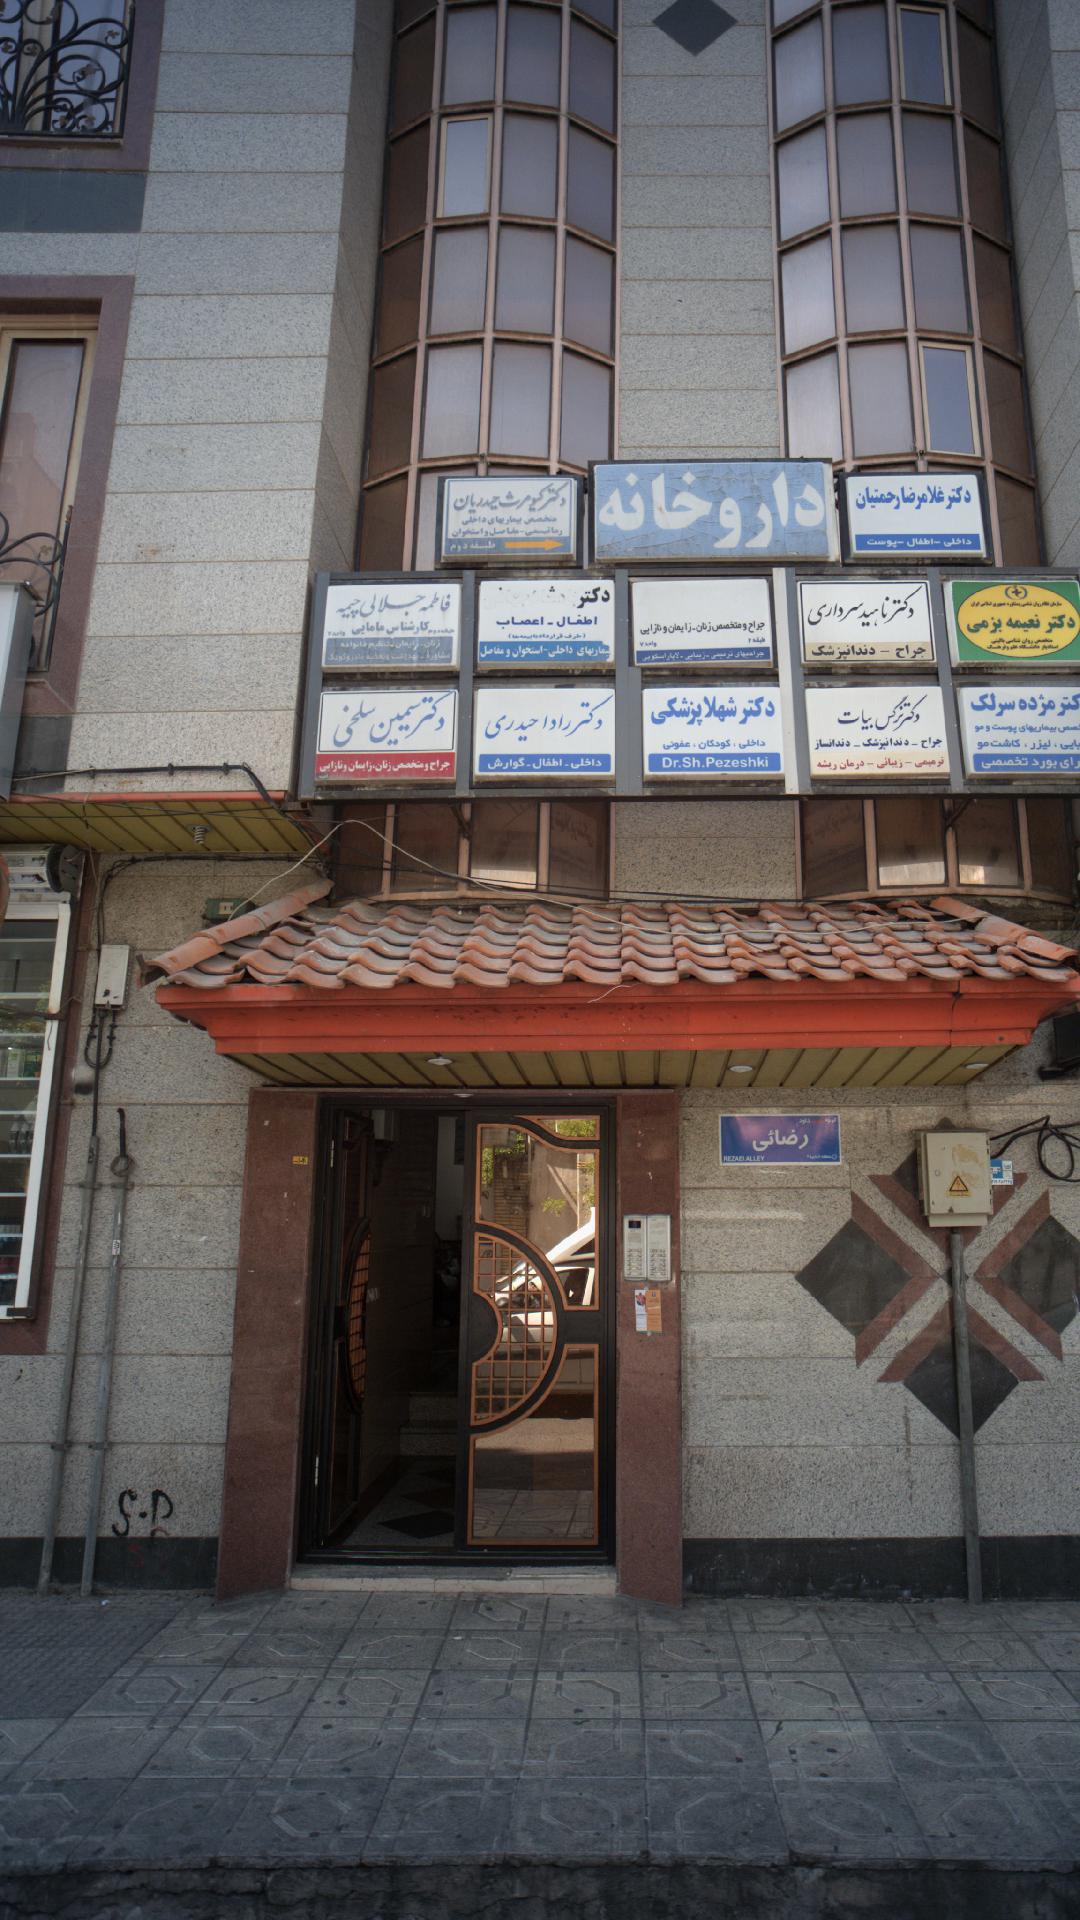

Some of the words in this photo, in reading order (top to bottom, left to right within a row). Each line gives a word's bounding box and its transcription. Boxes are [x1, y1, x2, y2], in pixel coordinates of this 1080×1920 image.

[500, 482, 554, 512] کیومرث
[538, 481, 569, 511] دکتر
[855, 487, 900, 510] رحمتیان
[900, 485, 945, 510] غلامرضا
[945, 486, 971, 510] دکتر
[454, 493, 500, 513] حیدریان
[598, 472, 826, 549] داروخانه
[462, 515, 485, 526] داخلی
[523, 515, 557, 525] متخصص
[450, 543, 468, 553] دوم
[470, 540, 496, 550] طبقه
[943, 538, 972, 547] داخلی
[419, 592, 451, 612] فاطمه
[577, 586, 610, 609] دکتر
[360, 593, 426, 617] جلالی
[884, 585, 922, 624] دکتر
[808, 602, 863, 625] سرداری
[857, 596, 890, 627] ناهید
[496, 616, 544, 629] اعصاب
[556, 614, 597, 627] اطفال
[695, 621, 711, 633] زنان
[712, 620, 742, 632] متخصص
[742, 622, 748, 631] و
[748, 620, 765, 633] جراح
[966, 616, 1002, 633] بزمی
[1006, 614, 1040, 632] نعیمه
[1045, 614, 1076, 633] دکتر
[352, 621, 384, 636] مامایی
[386, 620, 430, 636] کارشناس
[640, 623, 661, 635] نازایی
[662, 625, 668, 634] و
[668, 622, 692, 634] زایمان
[480, 645, 504, 658] مفاصل
[512, 645, 543, 658] استخوان
[548, 644, 574, 658] داخلی
[812, 645, 876, 660] دندانپزشک
[895, 645, 926, 658] جراح
[704, 695, 737, 722] شهلا
[739, 696, 775, 725] دکتر
[970, 692, 1016, 717] سرلک
[1019, 693, 1056, 717] مژده
[1057, 693, 1080, 717] کتر
[405, 690, 453, 739] دکتر
[565, 694, 613, 737] دکتر
[651, 697, 703, 726] پزشکی
[875, 694, 908, 730] نرگس
[893, 694, 927, 731] دکتر
[370, 703, 420, 746] سیمین
[837, 709, 873, 730] بیات
[485, 715, 538, 741] حیدری
[985, 724, 991, 732] و
[992, 723, 1017, 733] پوست
[1018, 723, 1057, 733] بیماریهای
[663, 740, 691, 750] عفونی
[698, 739, 731, 749] کودکان
[739, 739, 766, 749] داخلی
[815, 738, 851, 750] دندانساز
[862, 738, 909, 750] دندانپزشک
[921, 737, 942, 748] جراح
[977, 742, 990, 750] مو
[990, 739, 1020, 748] کاشت
[1030, 739, 1051, 750] لیزر
[348, 760, 372, 773] زایمان
[392, 760, 424, 771] متخصص
[430, 760, 450, 771] جراح
[488, 757, 525, 770] گوارش
[532, 758, 562, 769] اطفال
[570, 758, 602, 769] داخلی
[662, 756, 769, 768] Dr.Sh.Pezeshki
[817, 760, 837, 770] ریشه
[840, 758, 865, 770] درمان
[914, 757, 944, 768] ترمیمی
[981, 756, 1029, 769] تخصصی
[1032, 759, 1057, 769] بورد
[752, 1129, 809, 1152] رضائی
